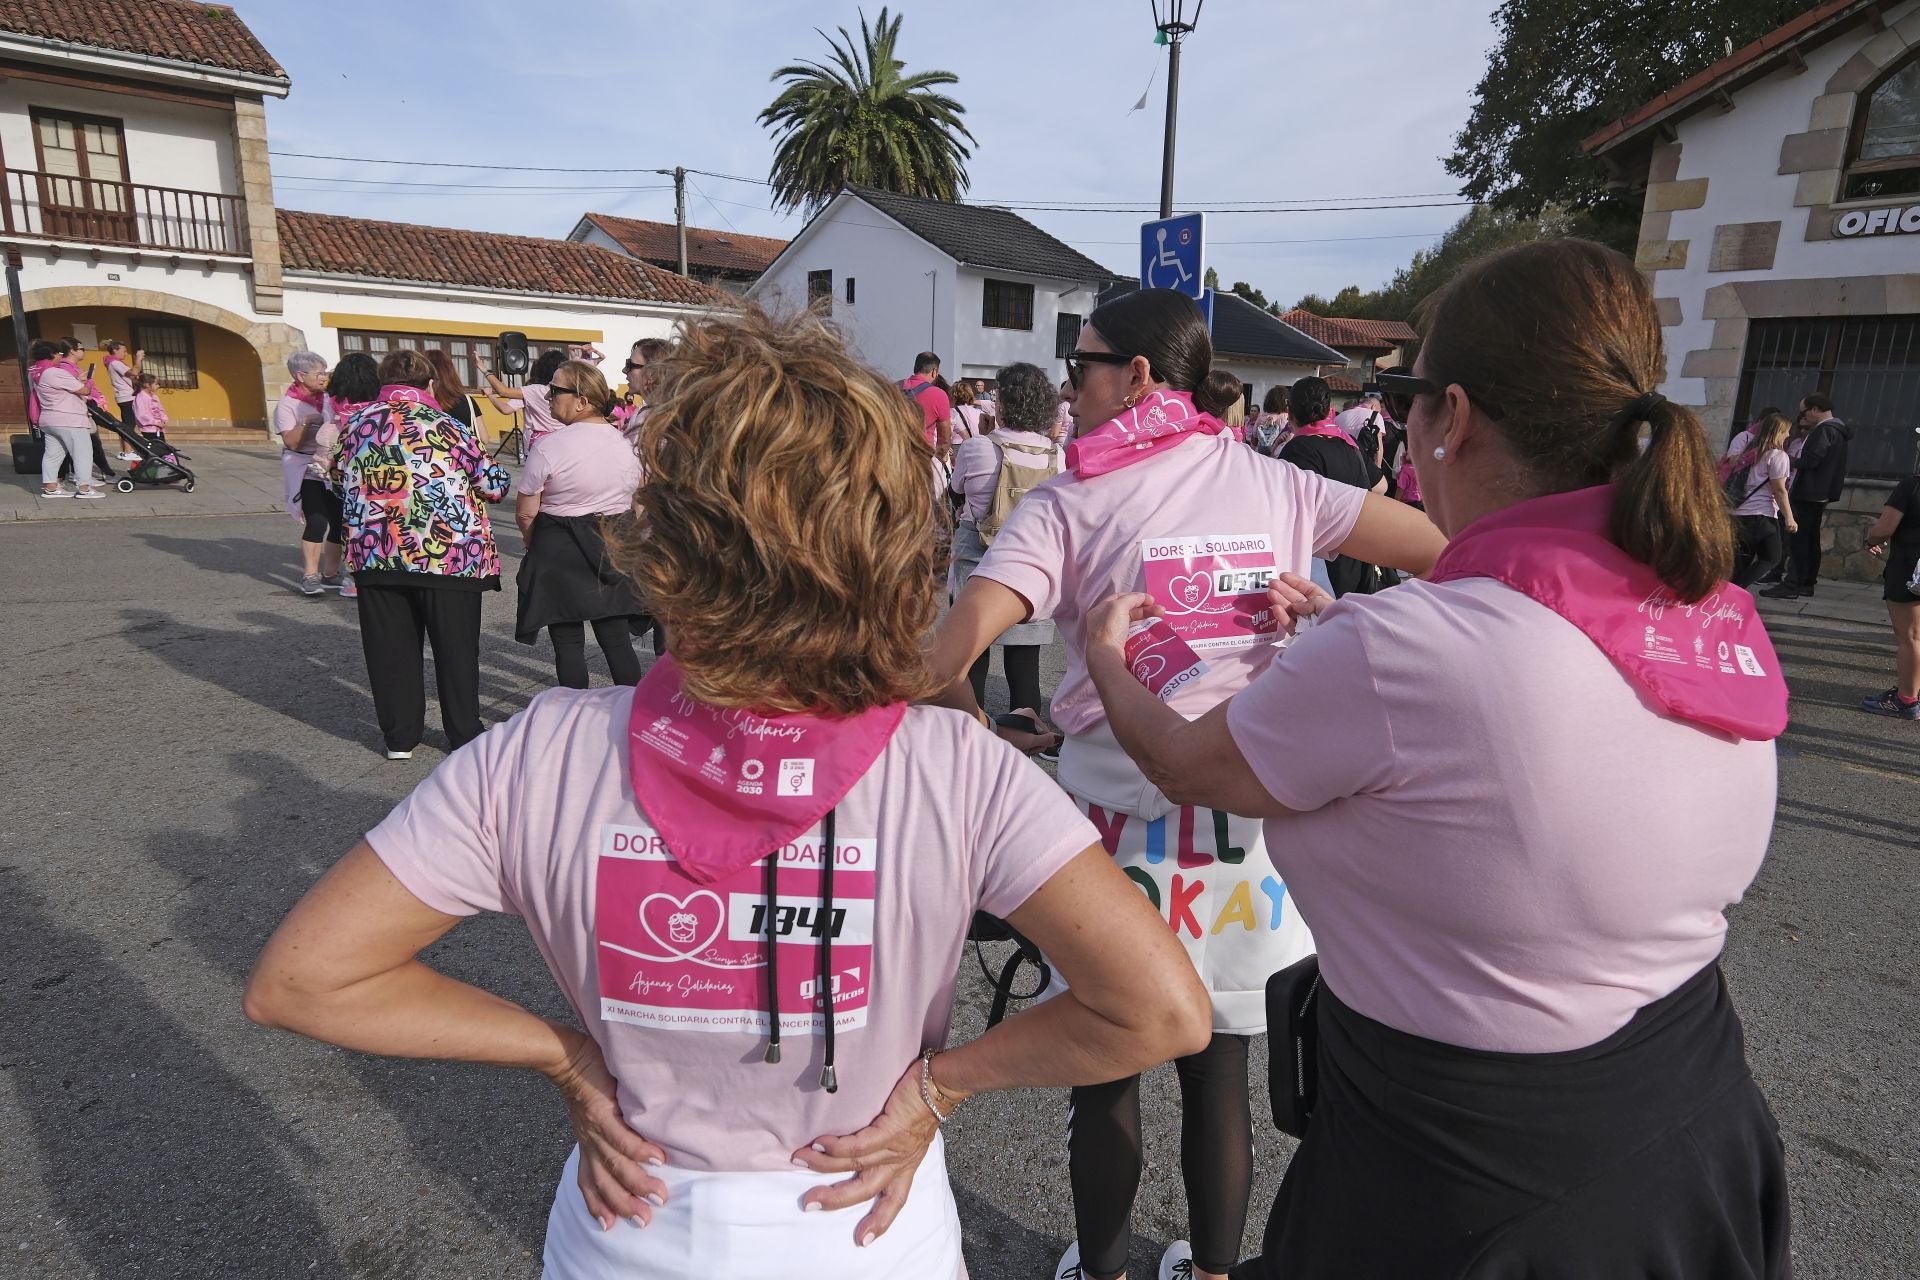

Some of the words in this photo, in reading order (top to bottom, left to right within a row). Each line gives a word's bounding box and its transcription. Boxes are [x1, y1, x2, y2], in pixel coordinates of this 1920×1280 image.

[1838, 205, 1920, 236] OFIC
[1205, 539, 1266, 553] SOLIDARIO
[1160, 667, 1201, 703] DORS
[736, 785, 763, 796] 2030
[613, 832, 673, 855] DOR
[628, 970, 675, 996] Anjanas
[677, 974, 735, 998] Solidarias
[617, 1007, 656, 1020] MARCHA
[658, 1013, 710, 1025] SOLIDARIA
[711, 1017, 753, 1026] CONTRA
[755, 1018, 767, 1026] EL
[835, 1016, 856, 1027] AMA
